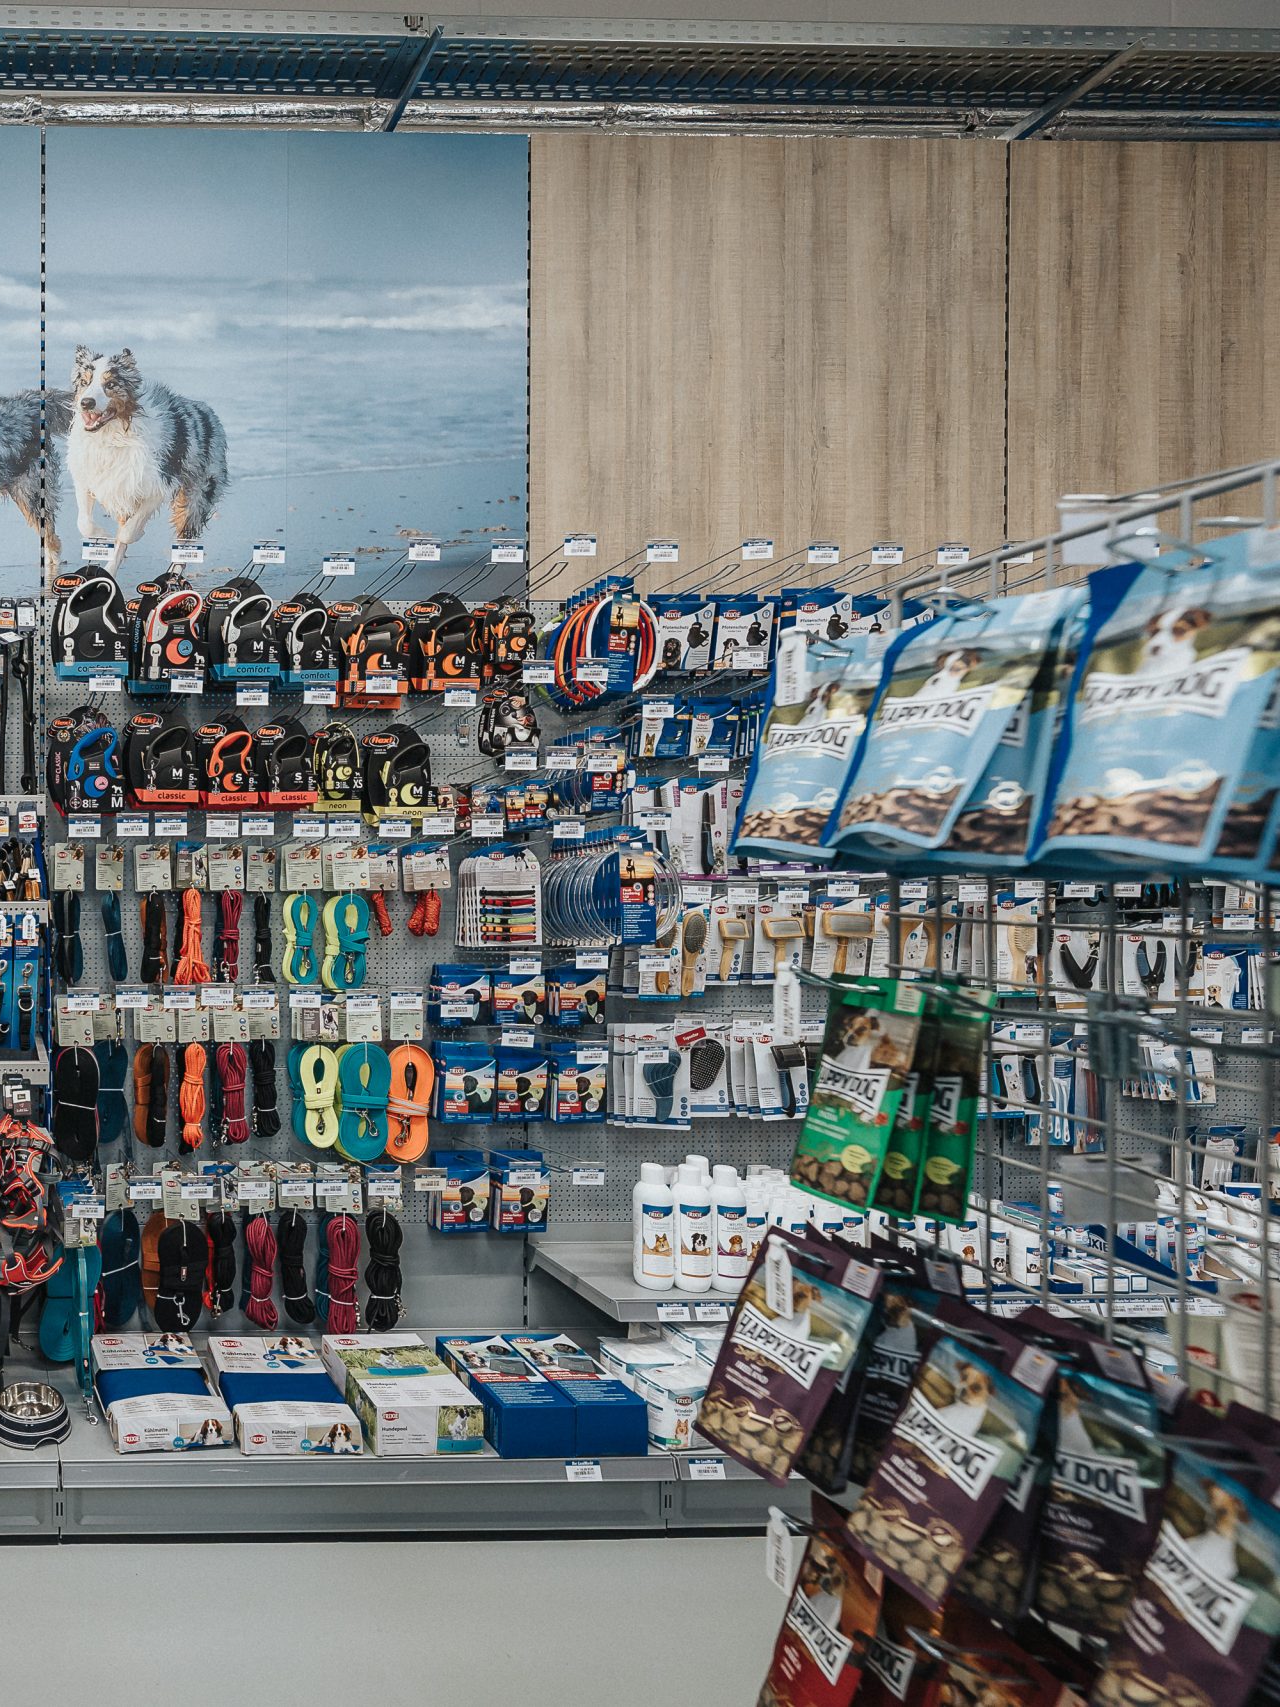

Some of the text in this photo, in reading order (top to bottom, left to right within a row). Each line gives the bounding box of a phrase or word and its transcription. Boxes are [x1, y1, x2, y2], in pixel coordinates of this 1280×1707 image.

[57, 578, 82, 586] flexi
[212, 591, 236, 599] flexi
[280, 605, 301, 613] flexi
[335, 604, 357, 612] flexi
[413, 605, 437, 614] flexi
[801, 603, 820, 612] TRIXIE
[95, 633, 104, 643] L
[253, 641, 263, 650] M
[315, 651, 323, 659] S
[382, 655, 390, 664] L
[526, 652, 535, 660] XS
[455, 656, 465, 665] M
[1165, 664, 1226, 699] DOG
[933, 696, 980, 724] DOG
[134, 715, 157, 724] flexi
[199, 726, 222, 736] flexi
[259, 728, 281, 737] flexi
[371, 735, 394, 744] flexi
[811, 726, 847, 751] DOG
[172, 768, 183, 777] M
[294, 773, 302, 781] S
[235, 773, 243, 782] S
[353, 779, 363, 788] XS
[413, 786, 423, 795] M
[634, 785, 650, 793] TRIXIE
[683, 786, 698, 794] TRIXIE
[157, 791, 186, 800] classic
[221, 794, 247, 802] classic
[281, 793, 307, 801] classic
[111, 796, 123, 808] M
[616, 834, 631, 842] TRIXIE
[850, 1076, 879, 1101] DOG
[736, 1313, 785, 1351] HAPPY
[781, 1344, 817, 1374] DOG
[382, 1412, 399, 1420] TRIXIE
[124, 1435, 140, 1443] TRIXIE
[941, 1437, 987, 1480] DOG
[1076, 1464, 1132, 1503] DOG
